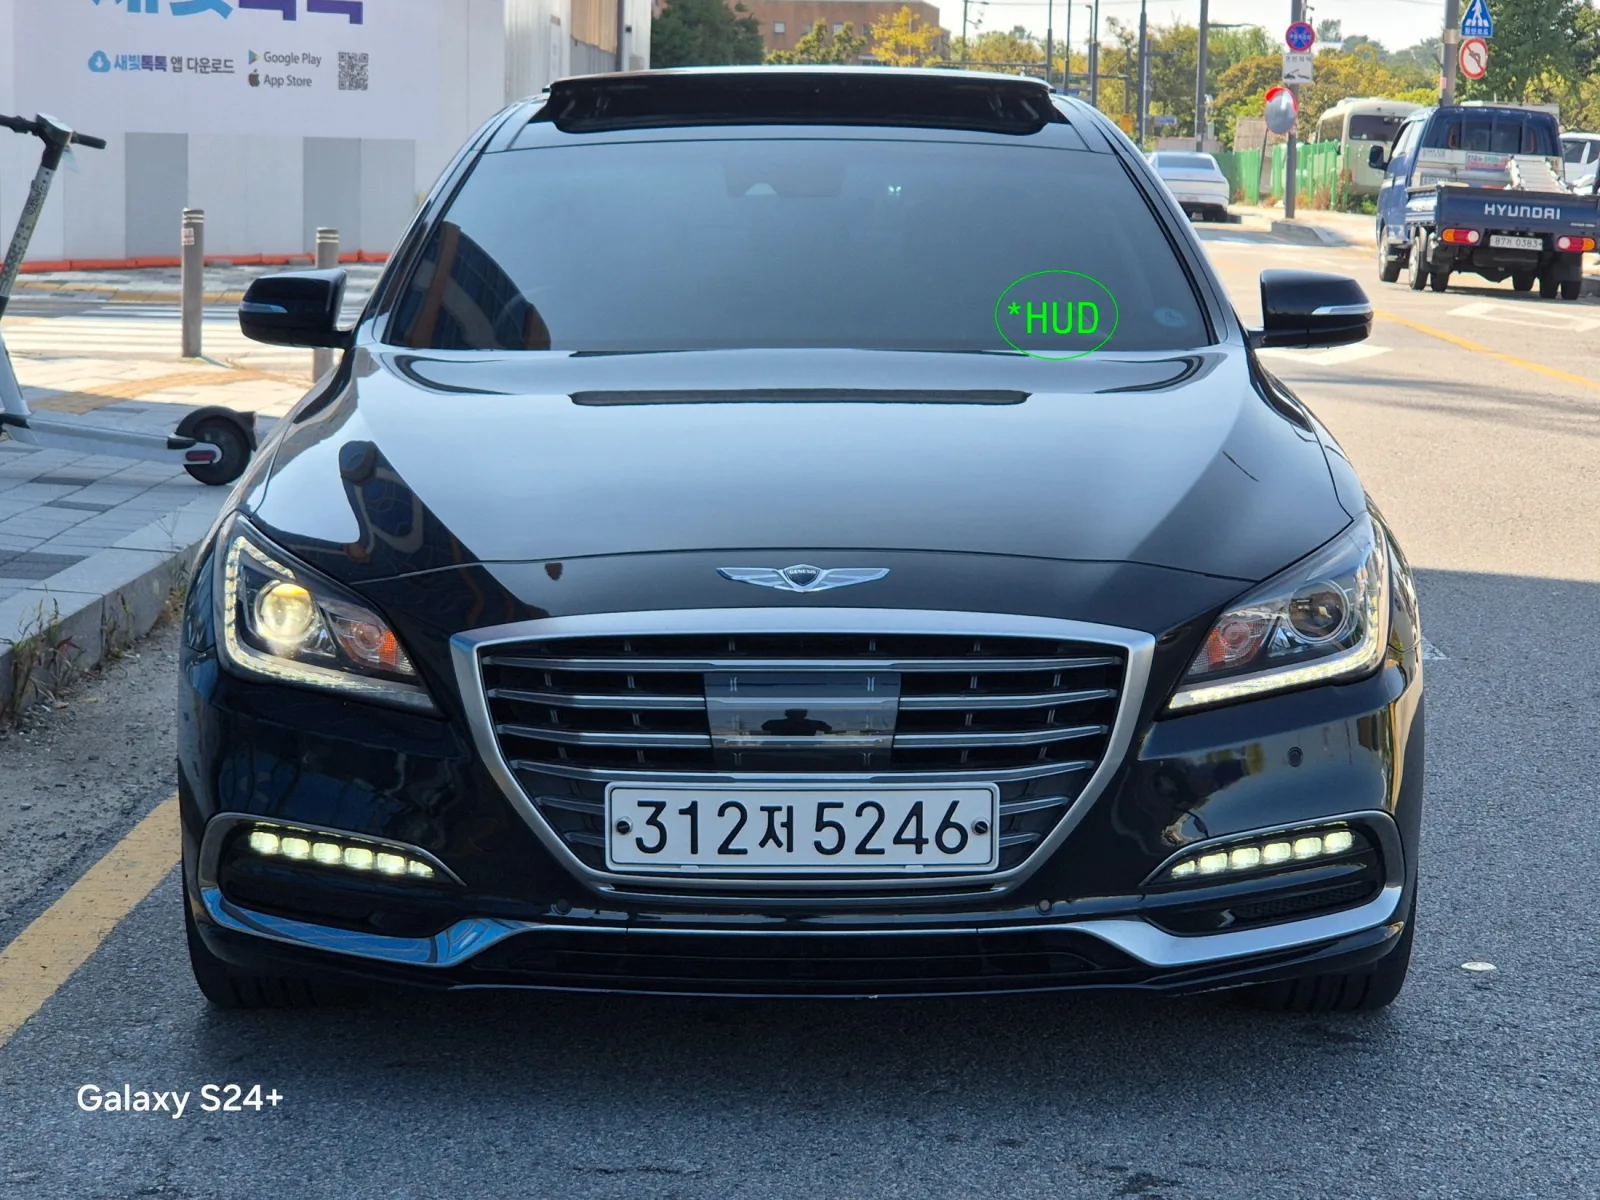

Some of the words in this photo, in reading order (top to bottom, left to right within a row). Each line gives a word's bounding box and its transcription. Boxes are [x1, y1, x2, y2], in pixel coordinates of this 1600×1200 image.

[114, 54, 167, 72] 새빛톡톡
[171, 57, 183, 73] 앱
[186, 57, 235, 74] 다운로드
[263, 51, 299, 65] Google
[301, 53, 322, 67] Play
[263, 74, 284, 88] App
[287, 75, 312, 87] Store
[1484, 203, 1560, 220] HYUNDAI
